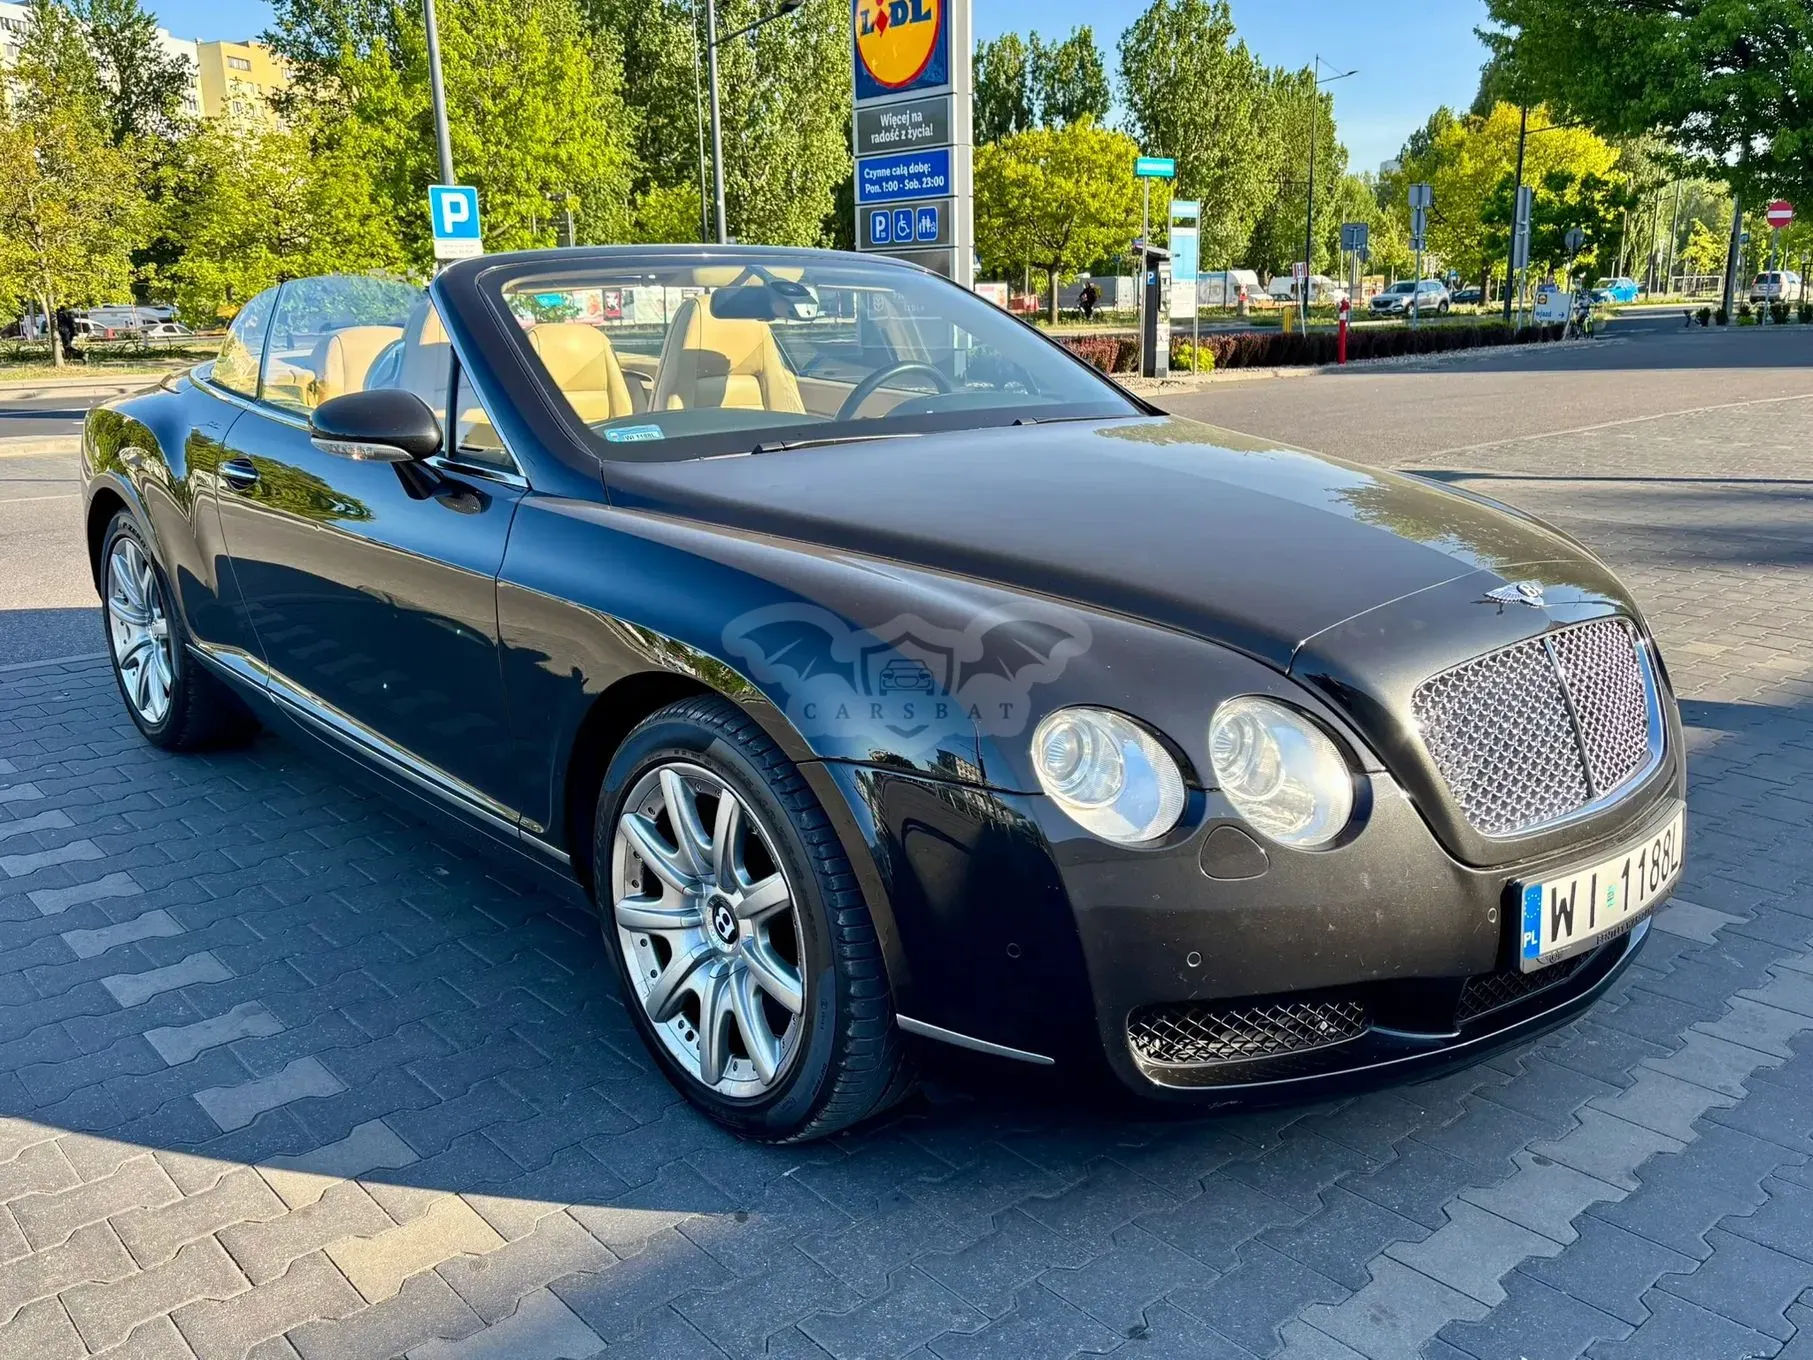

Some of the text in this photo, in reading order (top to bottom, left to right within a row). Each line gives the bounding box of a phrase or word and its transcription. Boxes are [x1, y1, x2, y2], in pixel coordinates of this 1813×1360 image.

[880, 110, 922, 128] Więcej na
[871, 123, 933, 144] radość z życia!
[864, 162, 931, 180] Czynne całą dobę:
[865, 184, 881, 193] Pon.
[883, 181, 898, 191] 1:00
[904, 179, 921, 190] Sob.
[922, 176, 944, 188] 23:00
[441, 192, 469, 233] P
[875, 215, 886, 238] P
[1147, 271, 1155, 283] P
[1551, 822, 1679, 943] WI 1188L
[1524, 931, 1538, 948] PL
